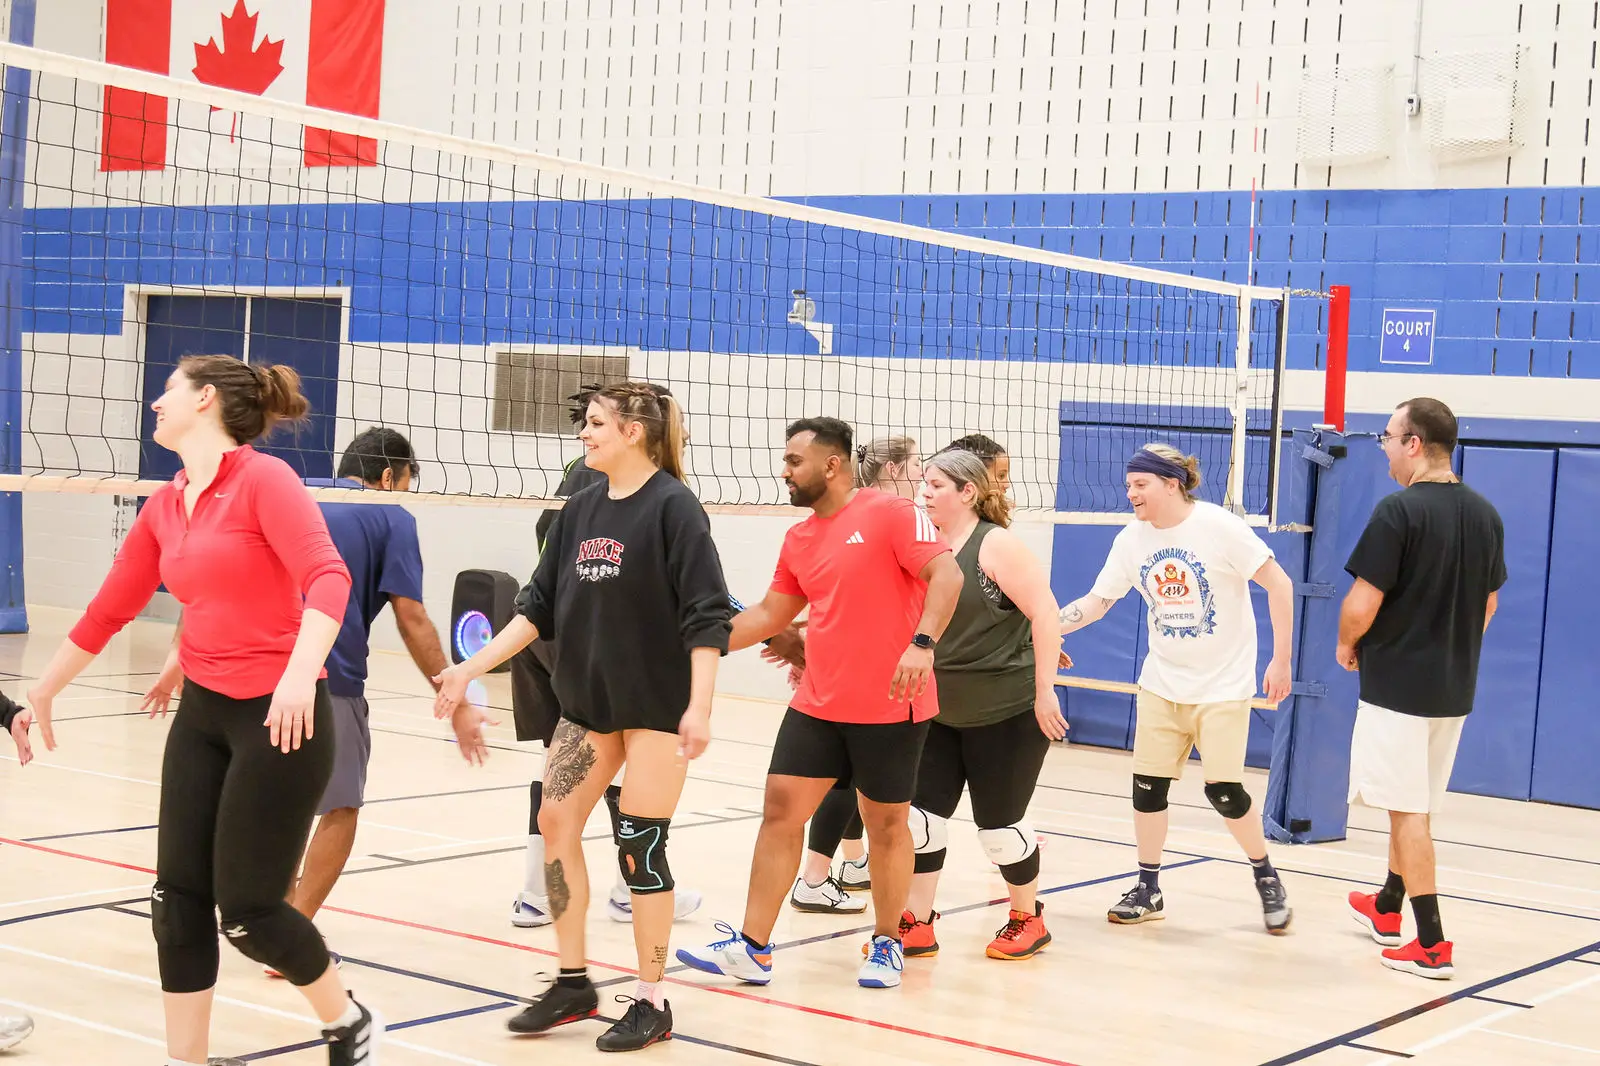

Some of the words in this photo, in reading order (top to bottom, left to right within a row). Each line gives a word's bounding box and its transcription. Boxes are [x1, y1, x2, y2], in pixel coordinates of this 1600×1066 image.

[1385, 320, 1431, 336] COURT
[1403, 338, 1410, 352] 4
[576, 537, 624, 566] NIKE
[1152, 547, 1187, 562] OKINAWA
